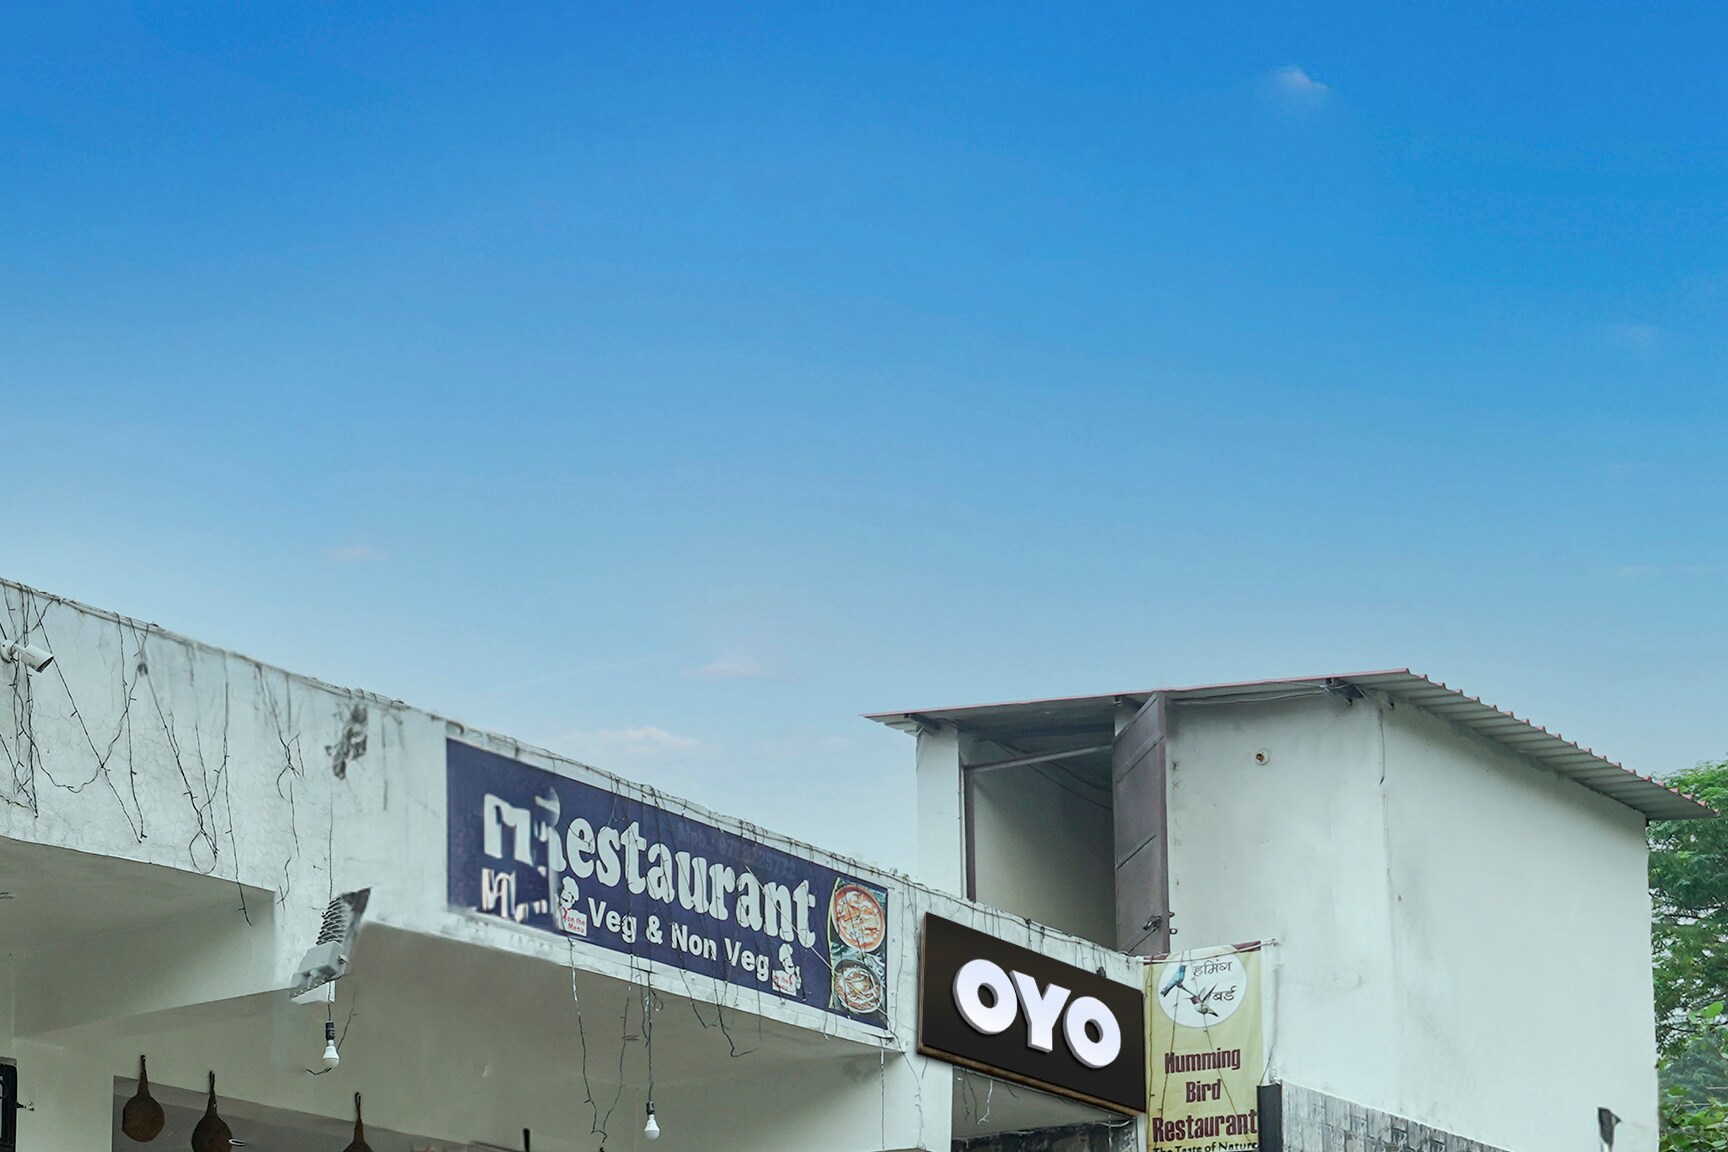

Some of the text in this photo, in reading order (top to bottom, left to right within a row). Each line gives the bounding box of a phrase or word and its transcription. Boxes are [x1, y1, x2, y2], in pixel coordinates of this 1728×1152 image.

[588, 897, 769, 982] Veg & Non Veg
[1212, 985, 1236, 1001] बर्ड
[953, 958, 1121, 1068] OYO
[1165, 1047, 1241, 1074] Humming
[1185, 1079, 1221, 1103] Bird
[1152, 1109, 1258, 1143] Restaurant
[1205, 1141, 1216, 1152] of
[1218, 1141, 1258, 1151] Nature
